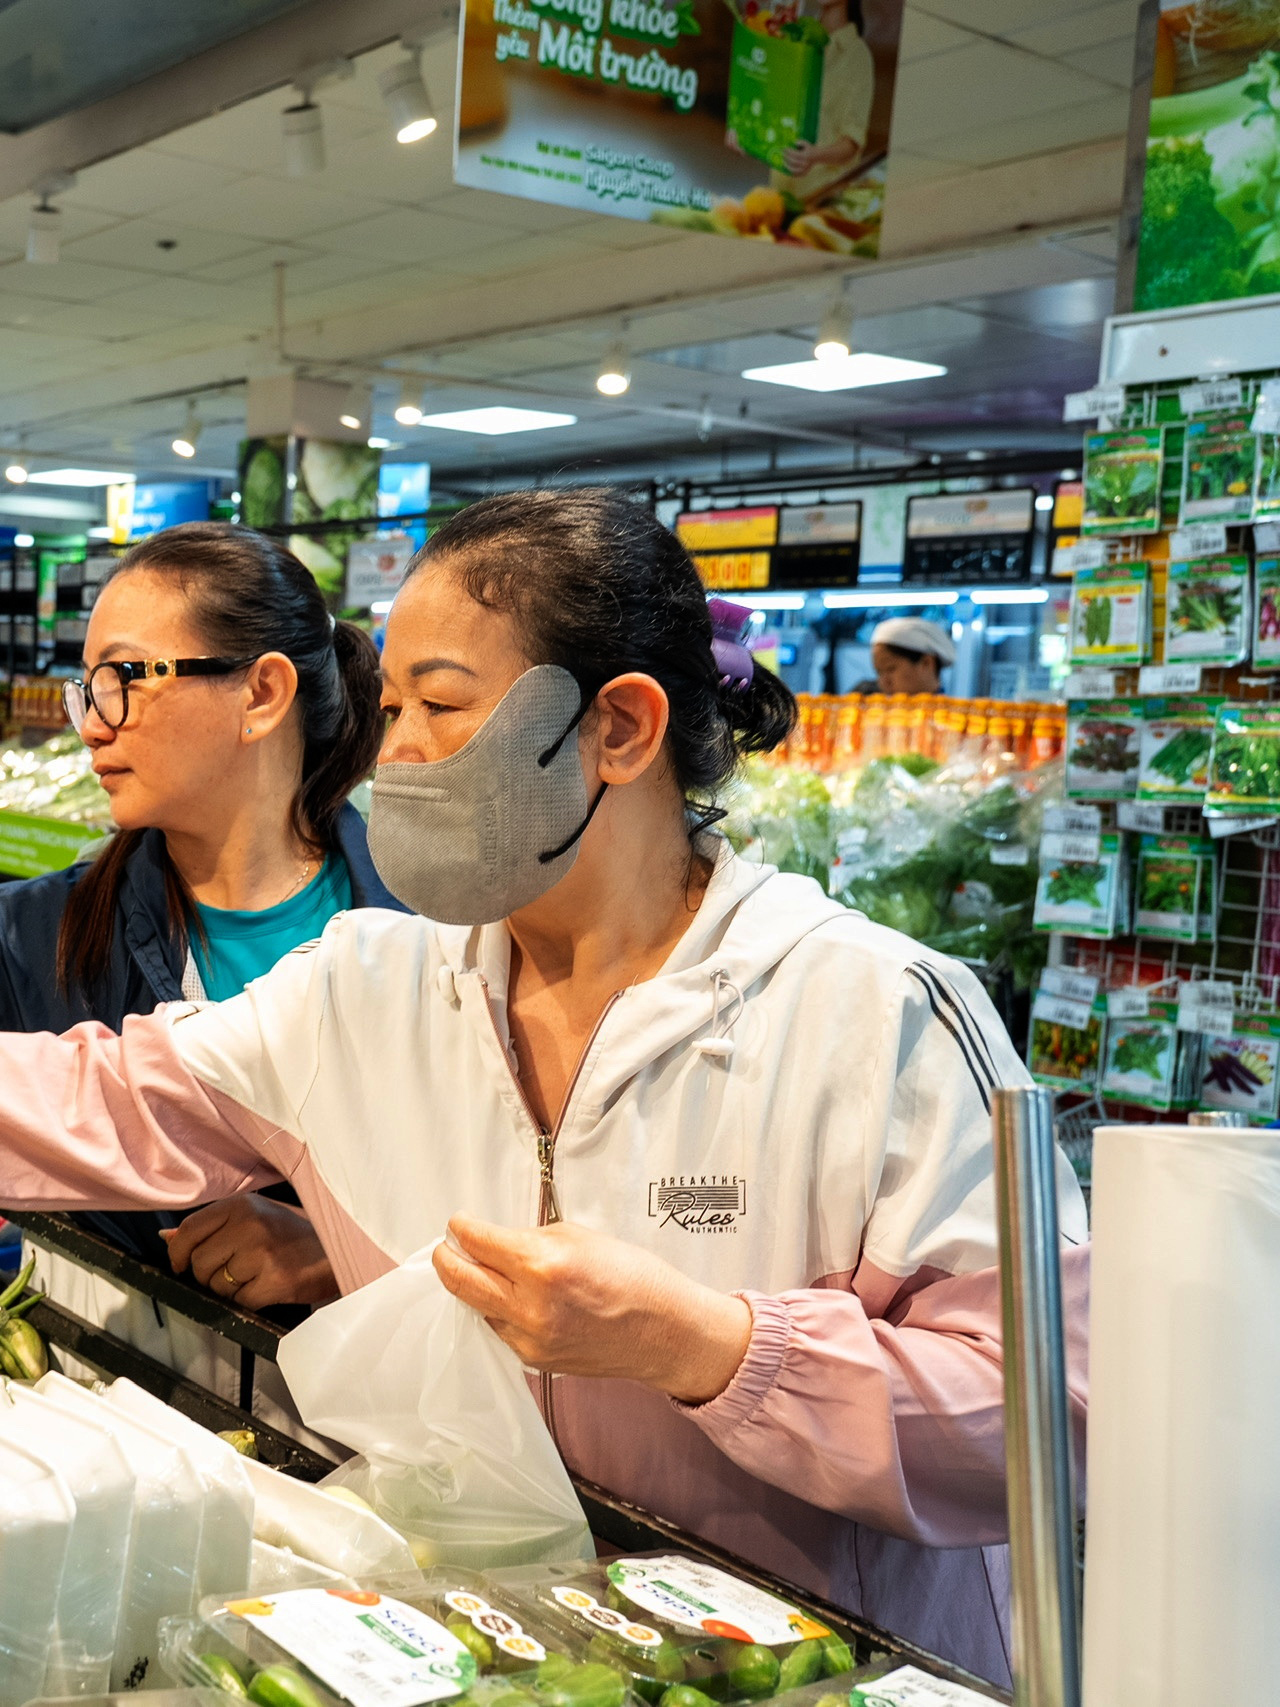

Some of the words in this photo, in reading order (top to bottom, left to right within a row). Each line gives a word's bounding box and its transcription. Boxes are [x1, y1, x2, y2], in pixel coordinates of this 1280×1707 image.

[530, 0, 603, 32] ng
[538, 20, 597, 74] Môi
[599, 39, 698, 109] trường
[660, 1191, 735, 1231] Rules
[690, 1226, 738, 1234] AUTHENTIC
